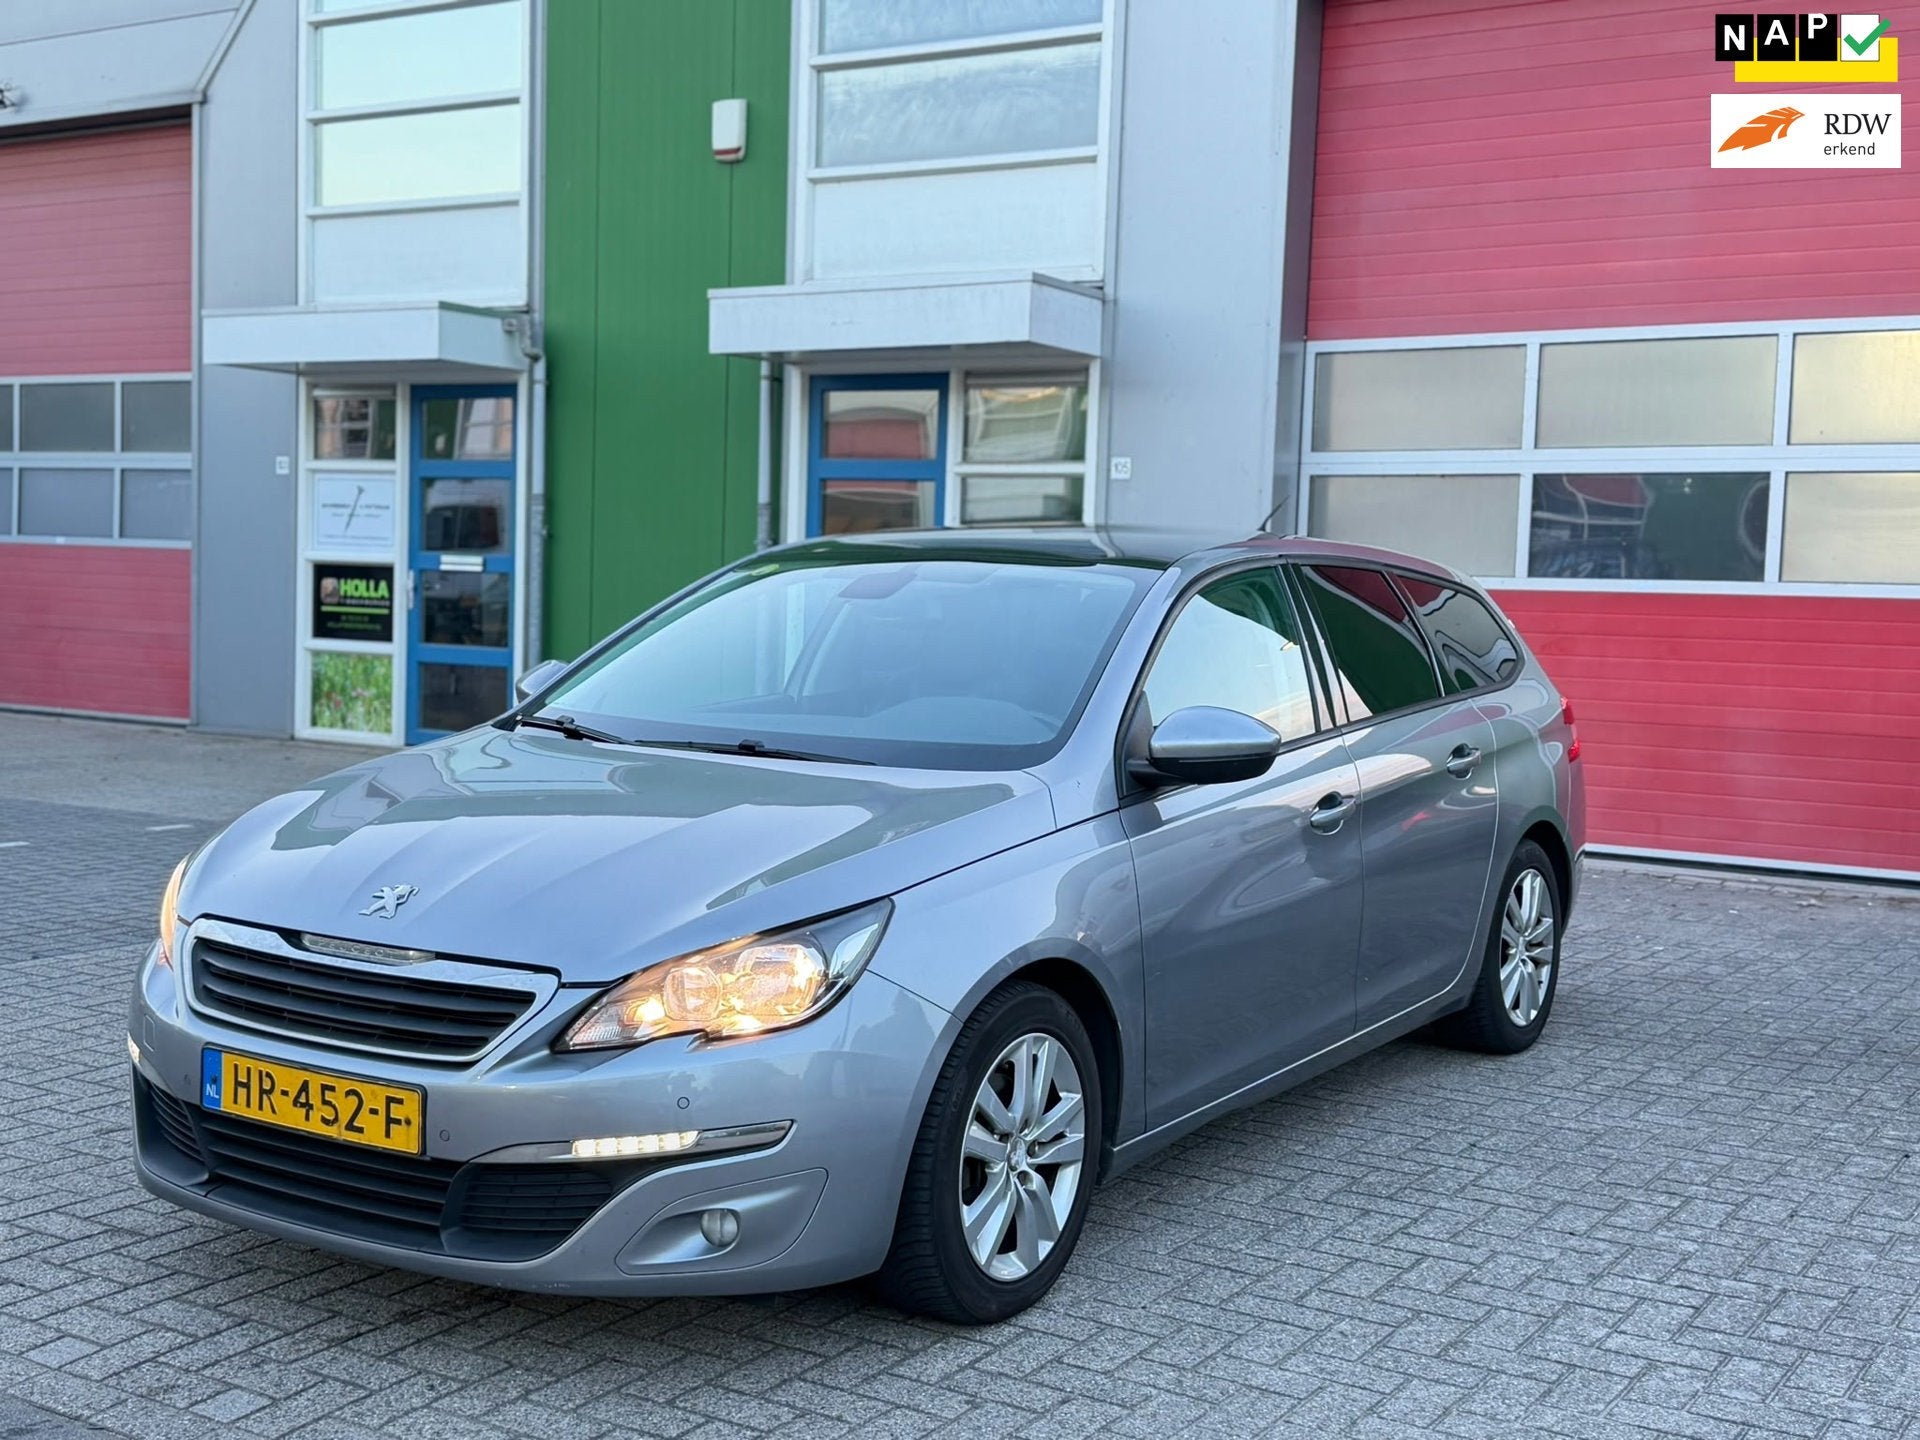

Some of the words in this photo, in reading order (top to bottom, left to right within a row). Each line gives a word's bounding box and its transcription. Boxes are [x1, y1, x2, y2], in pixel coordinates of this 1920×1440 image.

[340, 578, 390, 599] HOLLA
[205, 1084, 220, 1099] NL
[233, 1062, 406, 1139] HR-452-F
